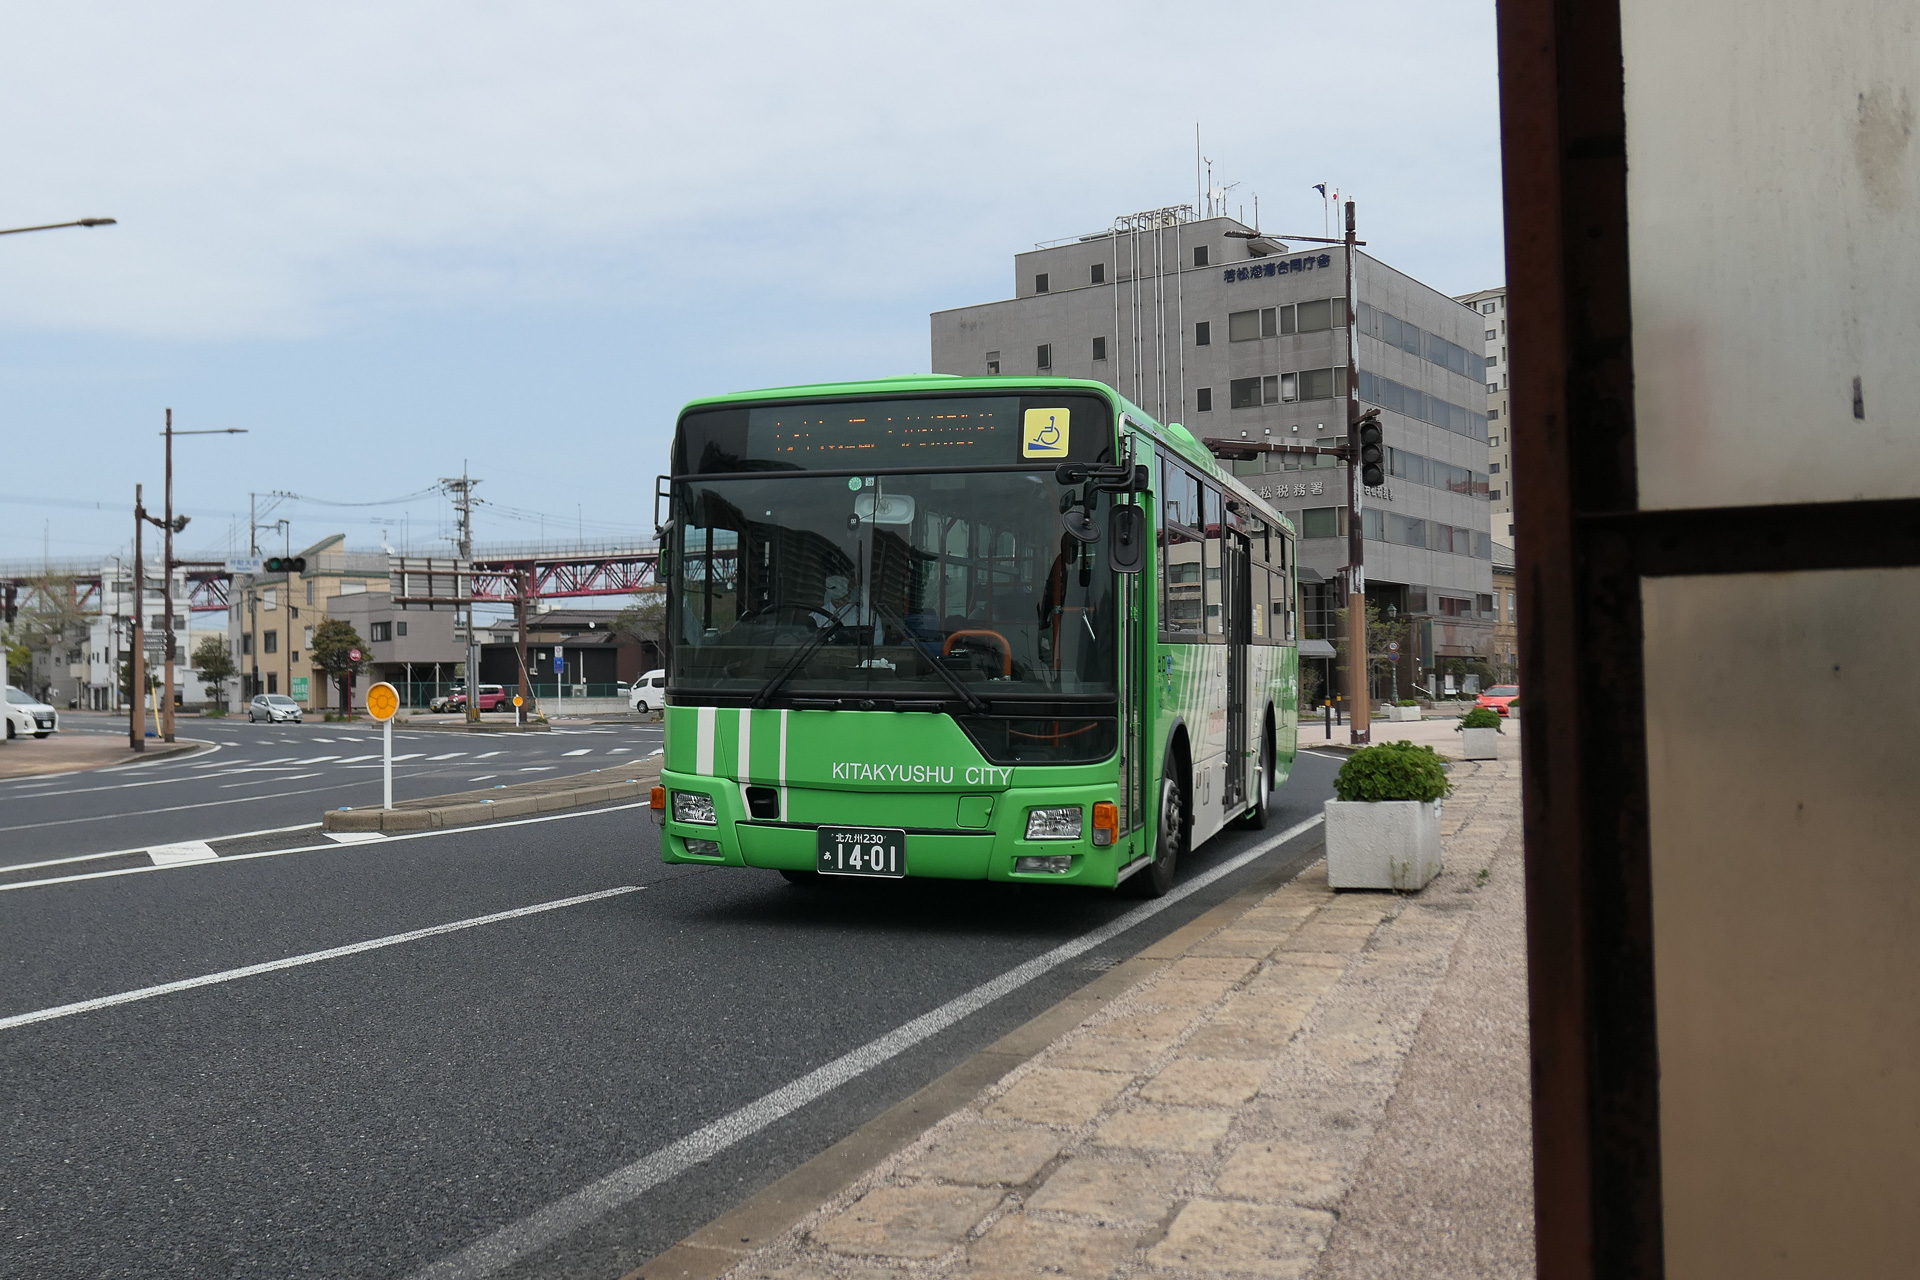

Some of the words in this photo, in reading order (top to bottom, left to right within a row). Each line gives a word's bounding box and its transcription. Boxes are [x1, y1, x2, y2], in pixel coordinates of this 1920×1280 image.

[1250, 481, 1324, 499] 松税務署
[832, 762, 954, 784] KITAKYUSHU
[965, 766, 1011, 785] CITY
[835, 833, 884, 844] 北九州230
[823, 851, 832, 861] あ
[838, 843, 896, 872] 14-01
